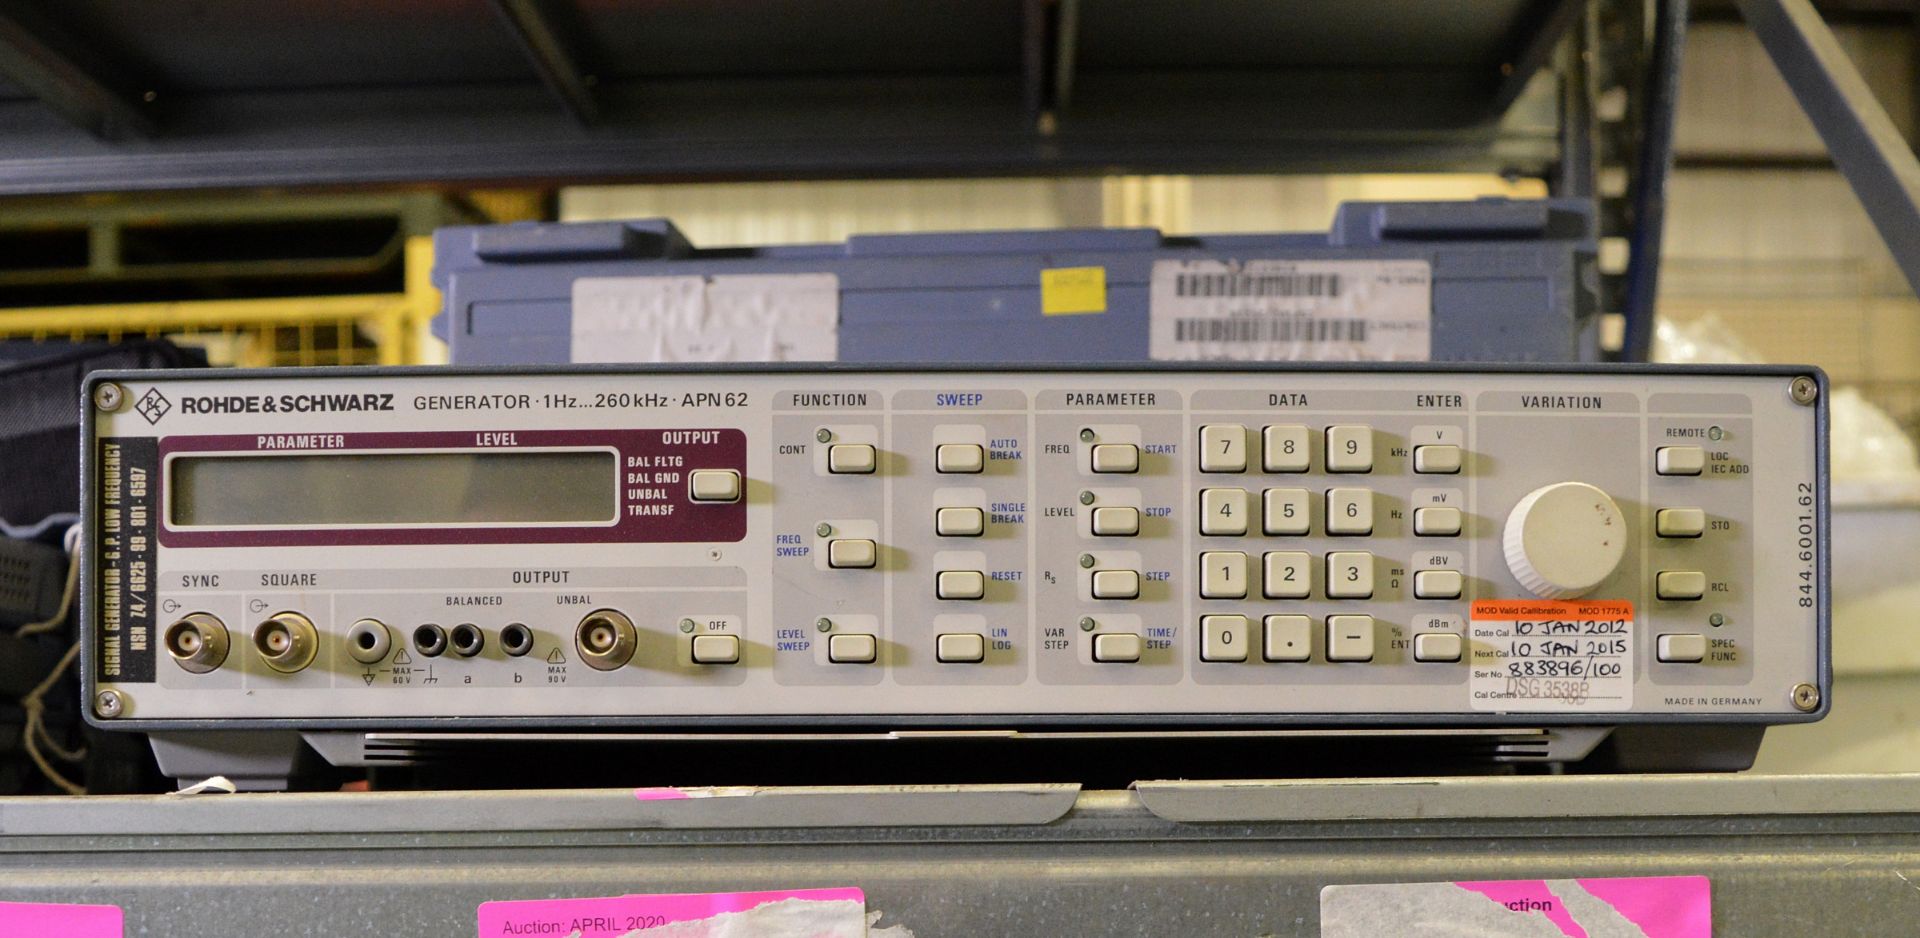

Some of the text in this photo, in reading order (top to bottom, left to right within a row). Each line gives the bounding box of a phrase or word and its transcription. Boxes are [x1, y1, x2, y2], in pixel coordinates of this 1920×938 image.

[413, 394, 531, 411] GENERATOR
[793, 393, 868, 407] FUNCTION
[936, 393, 984, 407] SWEEP
[1066, 392, 1157, 406] PARAMETER
[1269, 393, 1309, 407] DATA
[1416, 394, 1462, 408] ENTER
[1521, 395, 1602, 410] VARIATION
[476, 431, 518, 446] LEVEL
[661, 430, 721, 445] OUTPUT
[1436, 431, 1443, 440] V
[1666, 428, 1706, 438] REMOTE
[257, 434, 345, 449] PARAMETER
[990, 439, 1018, 449] AUTO
[1220, 439, 1232, 455] 7
[1283, 439, 1295, 455] 8
[1345, 439, 1358, 455] 9
[779, 445, 806, 455] CONT
[1044, 443, 1070, 455] FREQ
[1144, 444, 1177, 454] START
[1390, 448, 1408, 457] kHz
[989, 450, 1022, 460] BREAK
[1711, 452, 1729, 461] LOC
[627, 455, 683, 468] BAL FLTG
[104, 443, 122, 505] FREQUENCY
[1711, 464, 1750, 474] IEC ADD
[627, 472, 680, 484] BAL GND
[627, 487, 668, 500] UNBAL
[1432, 493, 1447, 503] mV
[627, 504, 675, 516] TRANSF
[990, 502, 1026, 513] SINGLE
[1044, 507, 1075, 517] LEVEL
[1144, 507, 1172, 518] STOP
[1219, 503, 1233, 518] 4
[1282, 503, 1295, 518] 5
[1345, 502, 1358, 518] 6
[990, 514, 1025, 524] BREAK
[1390, 509, 1403, 519] Hz
[104, 508, 121, 533] LOW
[1711, 520, 1730, 530] STO
[775, 534, 802, 545] FREQ
[1797, 482, 1813, 608] 844.6001.62
[776, 546, 810, 557] SWEEP
[1429, 556, 1449, 566] dBV
[512, 570, 570, 584] OUTPUT
[991, 571, 1022, 581] RESET
[1144, 571, 1171, 582] STEP
[1221, 565, 1231, 581] 1
[1283, 566, 1296, 582] 2
[1346, 566, 1359, 582] 3
[1391, 567, 1405, 576] ms
[182, 574, 220, 588] SYNC
[261, 573, 317, 587] SQUARE
[1711, 583, 1729, 592] RCL
[446, 596, 503, 607] BALANCED
[556, 594, 592, 606] UNBAL
[1476, 607, 1497, 615] MOD
[1499, 606, 1518, 615] Valid
[1578, 606, 1630, 615] MOD 1775 A
[708, 620, 728, 632] OFF
[1428, 619, 1450, 629] dBm
[1515, 618, 1628, 635] 10 JAN 2012
[776, 630, 805, 640] LEVEL
[991, 628, 1008, 638] LIN
[1044, 628, 1066, 638] VAR
[1146, 627, 1178, 638] TIME/
[1391, 628, 1403, 638] %
[1474, 627, 1510, 637] Date Cal
[130, 626, 147, 651] NSN
[1221, 630, 1233, 646] 0
[776, 641, 811, 652] SWEEP
[991, 640, 1012, 650] LOG
[1044, 640, 1070, 651] STEP
[1146, 639, 1172, 650] STEP
[1391, 640, 1410, 649] ENT
[1511, 639, 1627, 657] 10 JAN 2015
[1711, 639, 1736, 649] SPEC
[104, 634, 121, 676] SIGNAL
[1474, 649, 1510, 658] Next Cal
[1711, 652, 1737, 662] FUNC
[392, 667, 412, 675] MAX
[547, 666, 567, 674] MAX
[1508, 656, 1621, 681] 883896/100
[463, 674, 473, 686] a
[514, 671, 524, 685] b
[1474, 671, 1503, 679] Ser No
[1505, 677, 1541, 699] DSG
[1474, 690, 1518, 699] Cal Centre
[1664, 698, 1763, 706] MADE IN GERMANY
[1491, 898, 1552, 912] ction
[502, 921, 566, 935] Auction:
[570, 917, 621, 932] APRIL
